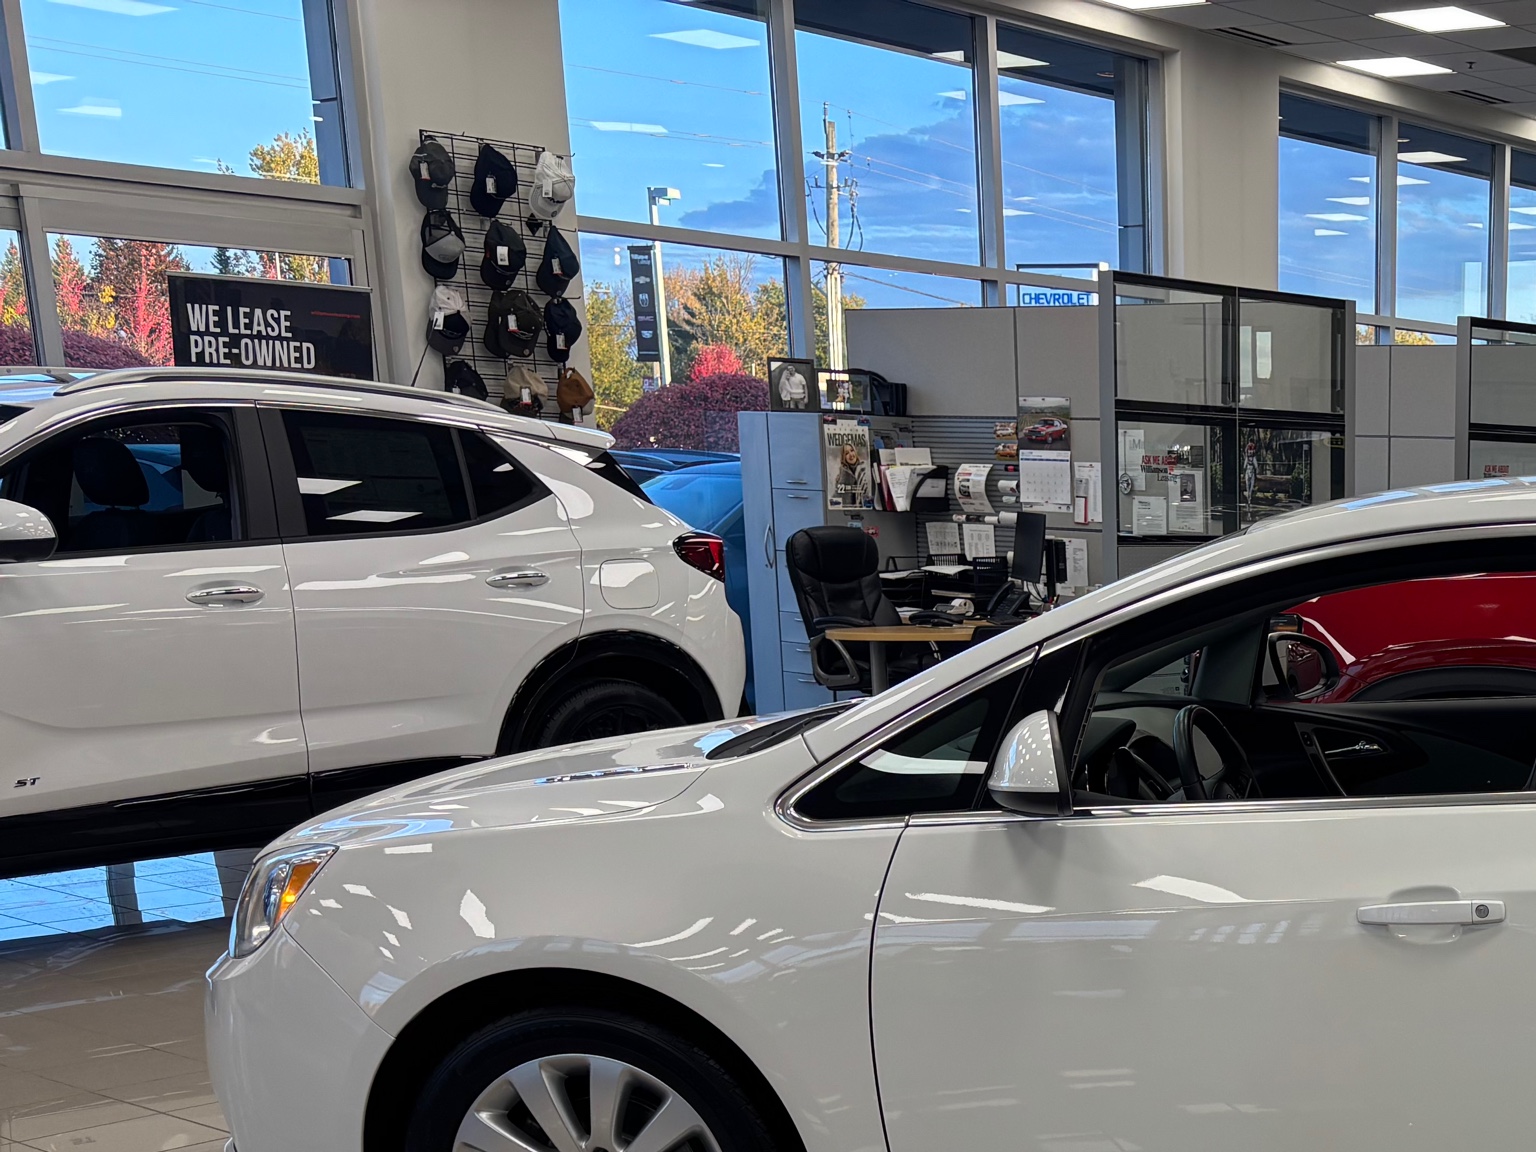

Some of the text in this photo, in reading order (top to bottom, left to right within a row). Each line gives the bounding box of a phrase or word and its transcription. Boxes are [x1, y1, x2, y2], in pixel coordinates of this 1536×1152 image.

[1022, 292, 1091, 306] CHEVROLET
[186, 303, 293, 338] WE LEASE
[189, 335, 316, 369] PRE-OWNED
[1141, 455, 1152, 465] ASK
[1152, 455, 1160, 465] ME
[13, 776, 41, 788] ST
